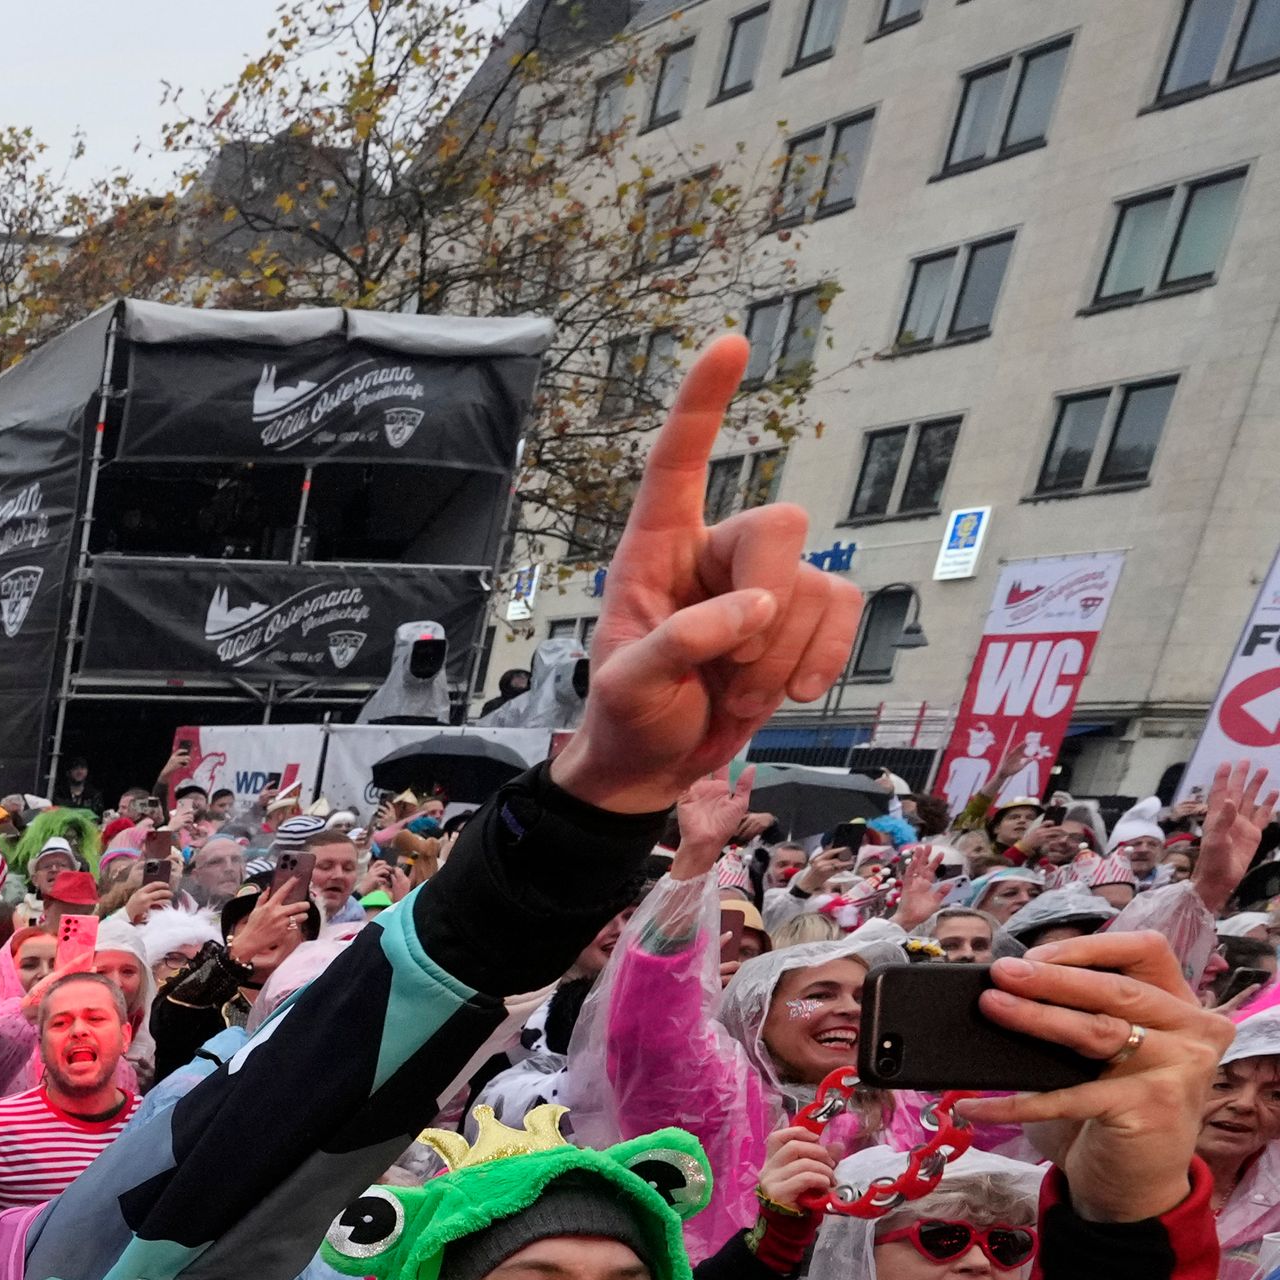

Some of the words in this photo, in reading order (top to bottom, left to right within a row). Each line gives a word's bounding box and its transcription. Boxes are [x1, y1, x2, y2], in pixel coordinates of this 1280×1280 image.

[261, 407, 310, 445] Willi
[311, 366, 414, 423] Ostermann
[217, 626, 263, 662] Willi
[264, 588, 364, 642] Ostermann
[972, 638, 1085, 719] WC
[236, 771, 267, 794] WD
